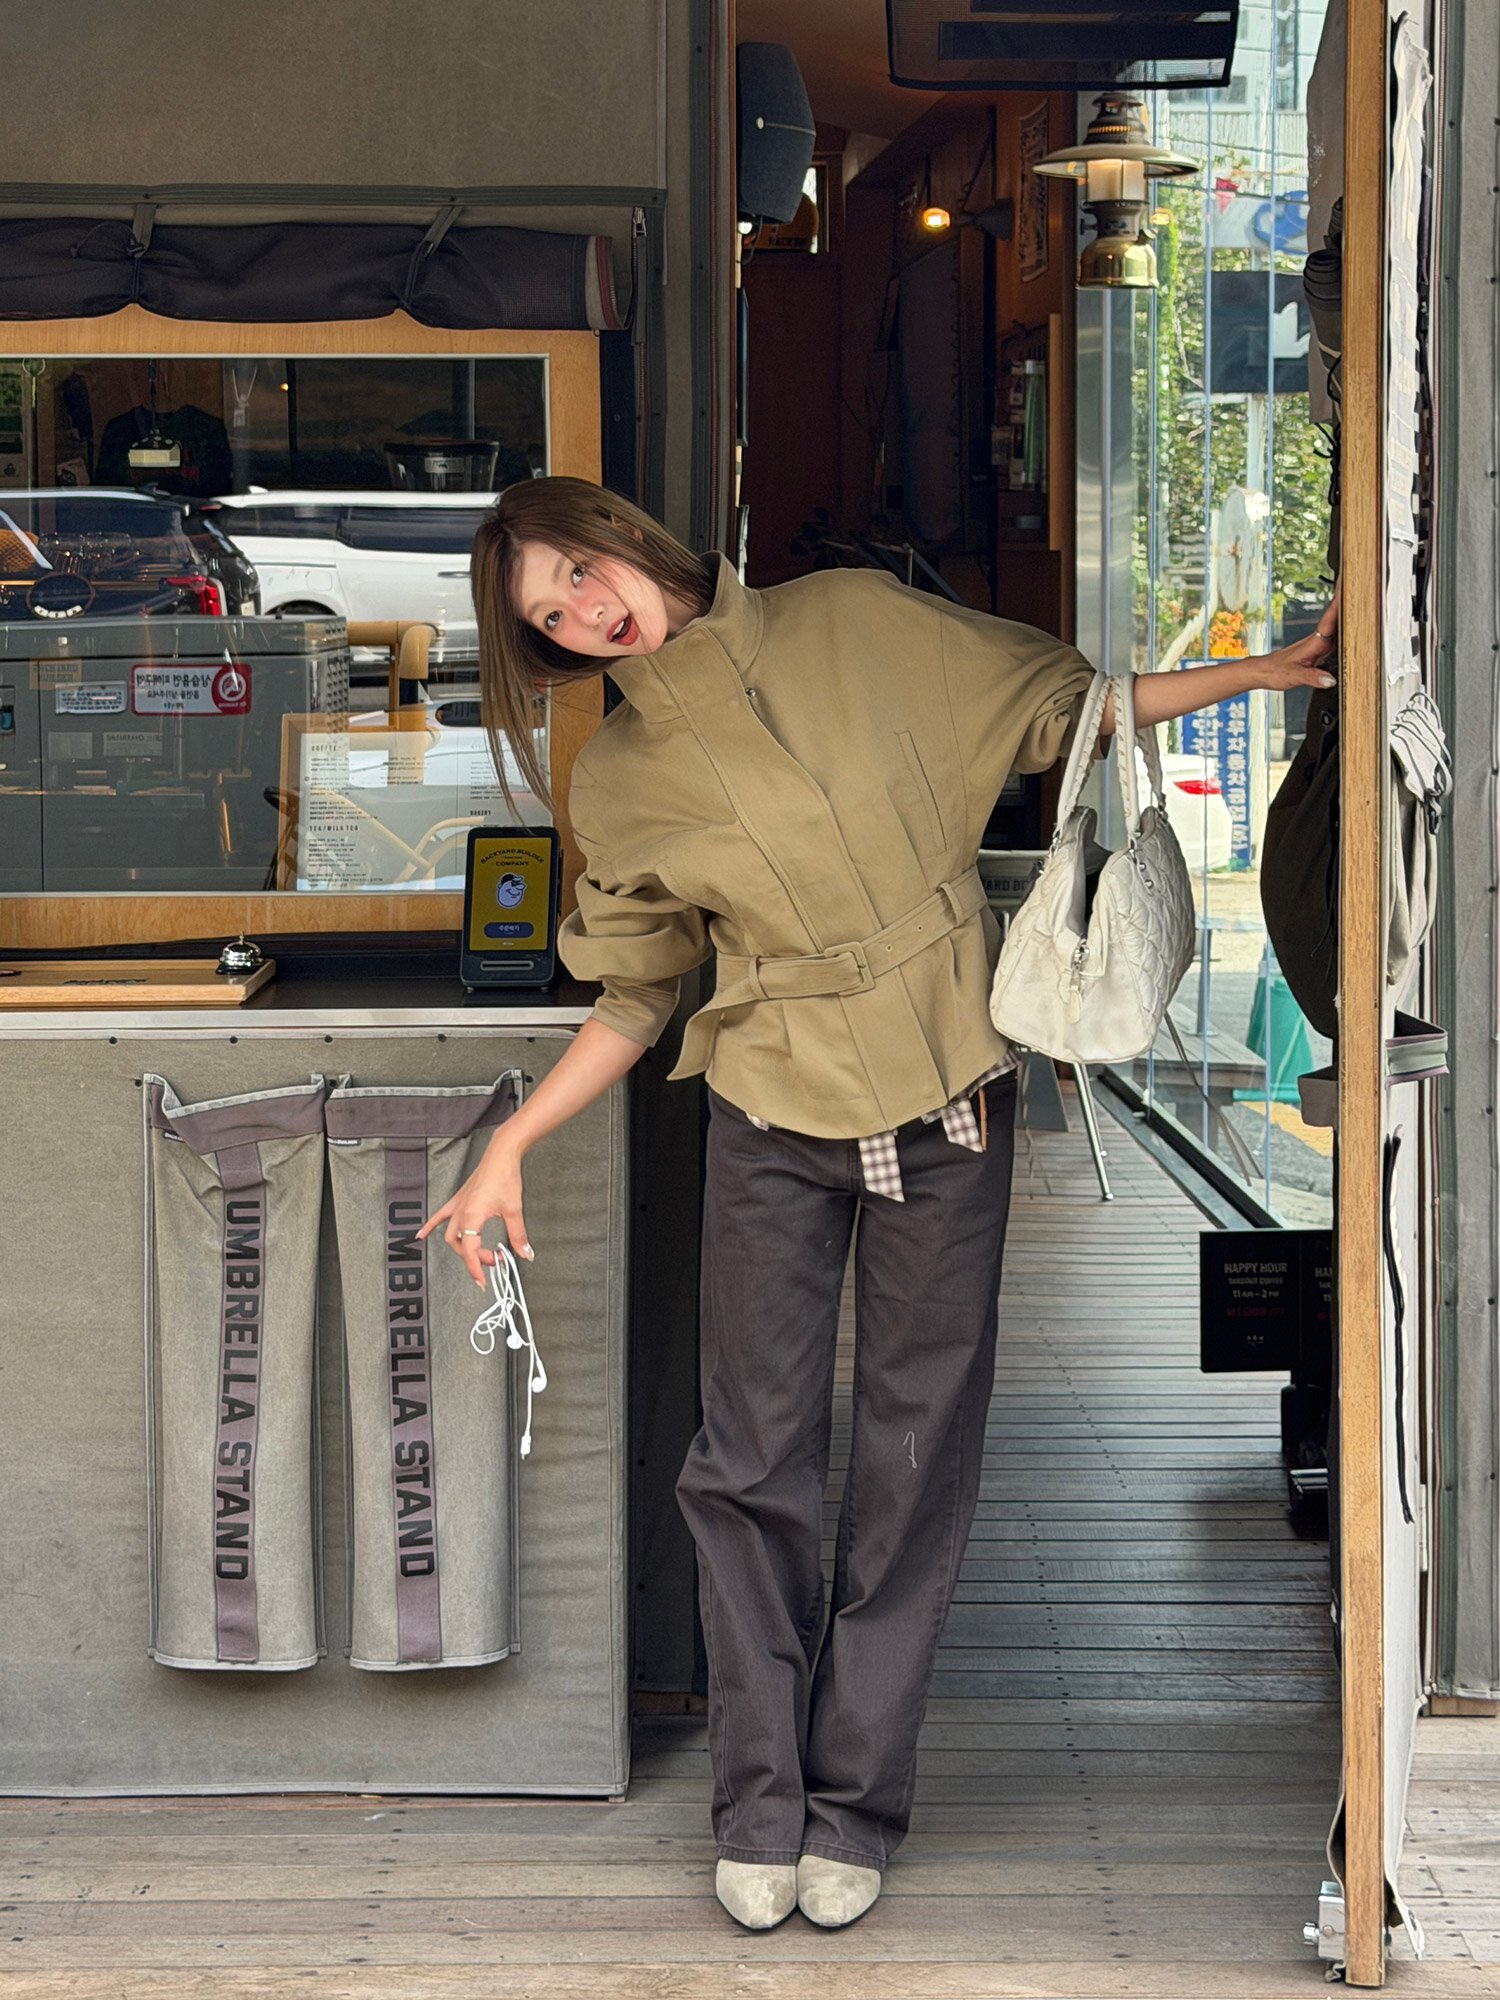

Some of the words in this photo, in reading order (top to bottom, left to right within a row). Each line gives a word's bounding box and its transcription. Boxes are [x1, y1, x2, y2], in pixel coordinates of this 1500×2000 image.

[221, 1201, 260, 1425] UMBRELLA
[388, 1201, 428, 1427] UMBRELLA
[1224, 1263, 1258, 1273] HAPPY
[1260, 1262, 1288, 1273] HOUR
[215, 1441, 252, 1580] STAND
[394, 1440, 435, 1577] STAND
